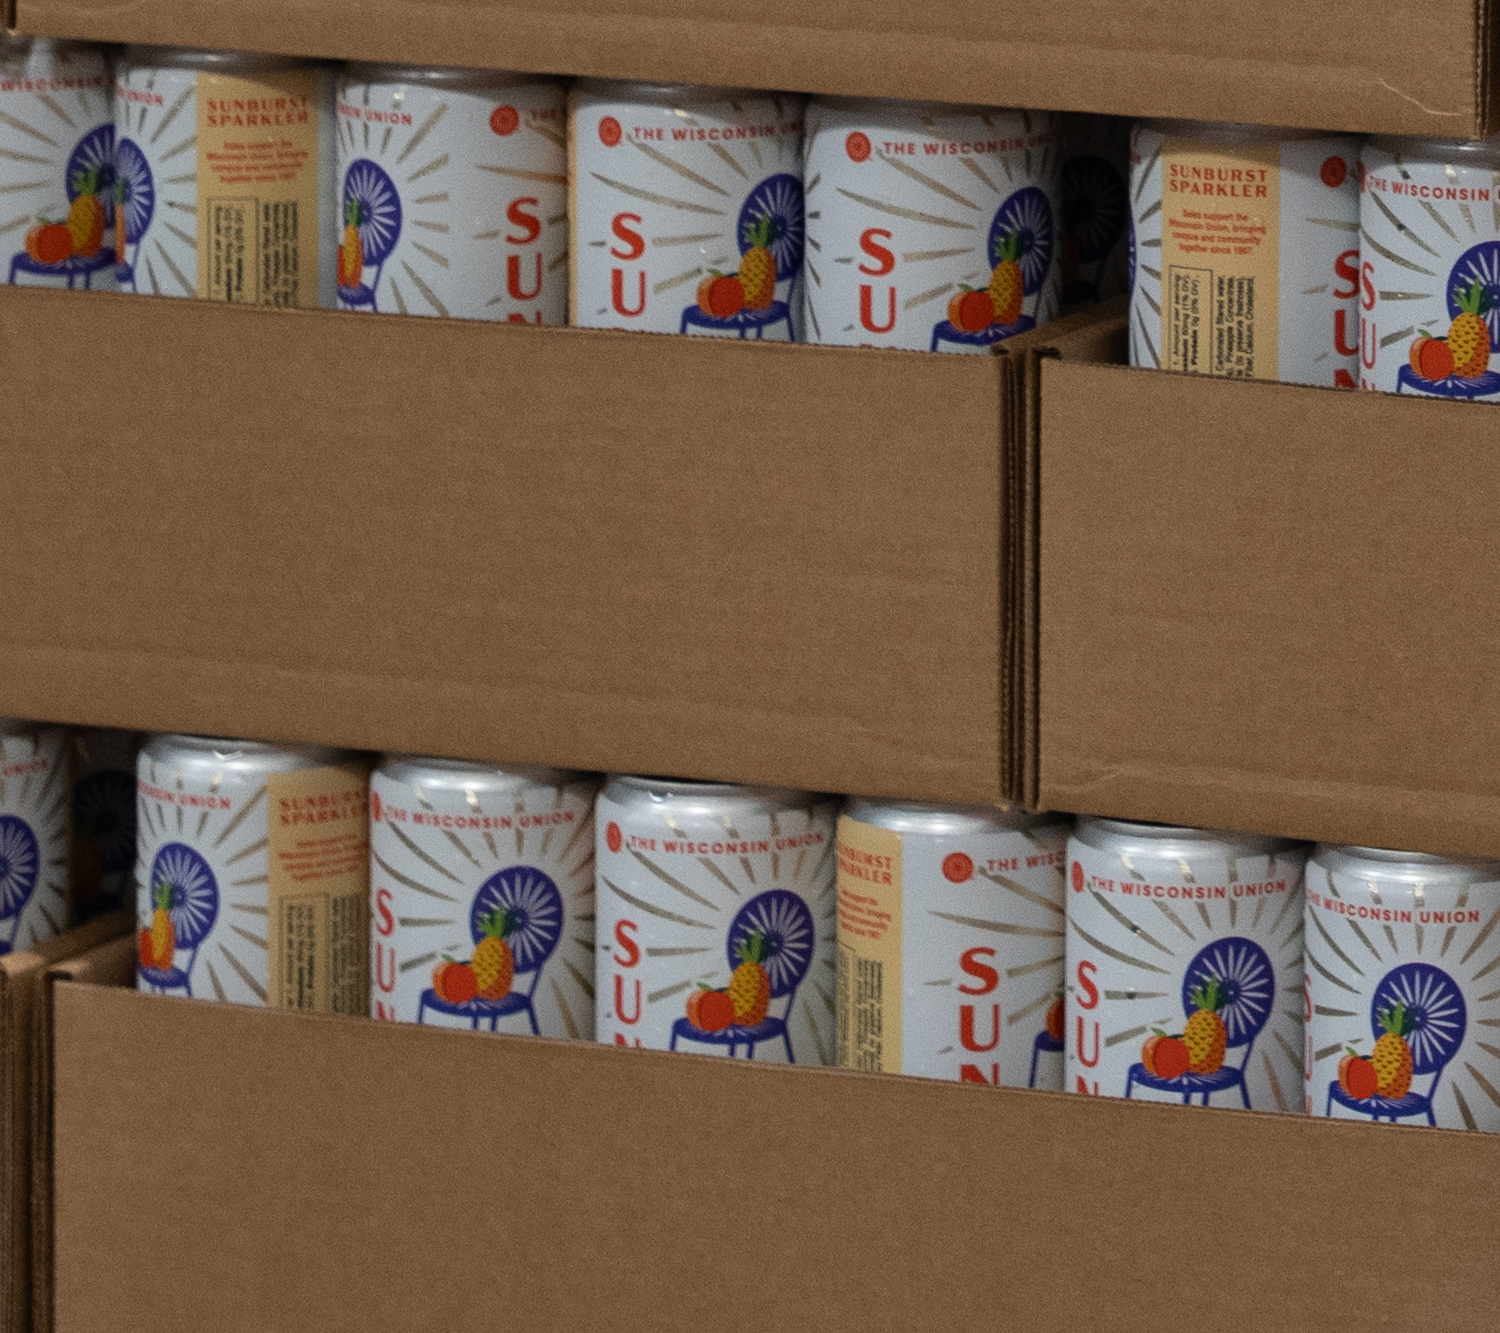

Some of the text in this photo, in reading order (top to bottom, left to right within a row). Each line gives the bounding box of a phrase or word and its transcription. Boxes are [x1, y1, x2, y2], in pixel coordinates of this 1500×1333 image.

[634, 124, 774, 141] THE WISCONSIN
[884, 141, 916, 155] THE
[1170, 164, 1268, 182] SUNBURST
[1170, 180, 1268, 198] SPARKLER
[1392, 181, 1490, 201] WISCONSIN
[413, 813, 512, 829] WISCONSIN
[631, 835, 656, 851] THE
[664, 841, 769, 854] WISCONSIN
[988, 858, 1018, 873] THE
[1092, 876, 1285, 899] THE WISCONSIN UNION
[1324, 896, 1479, 923] WISCONSIN UNION
